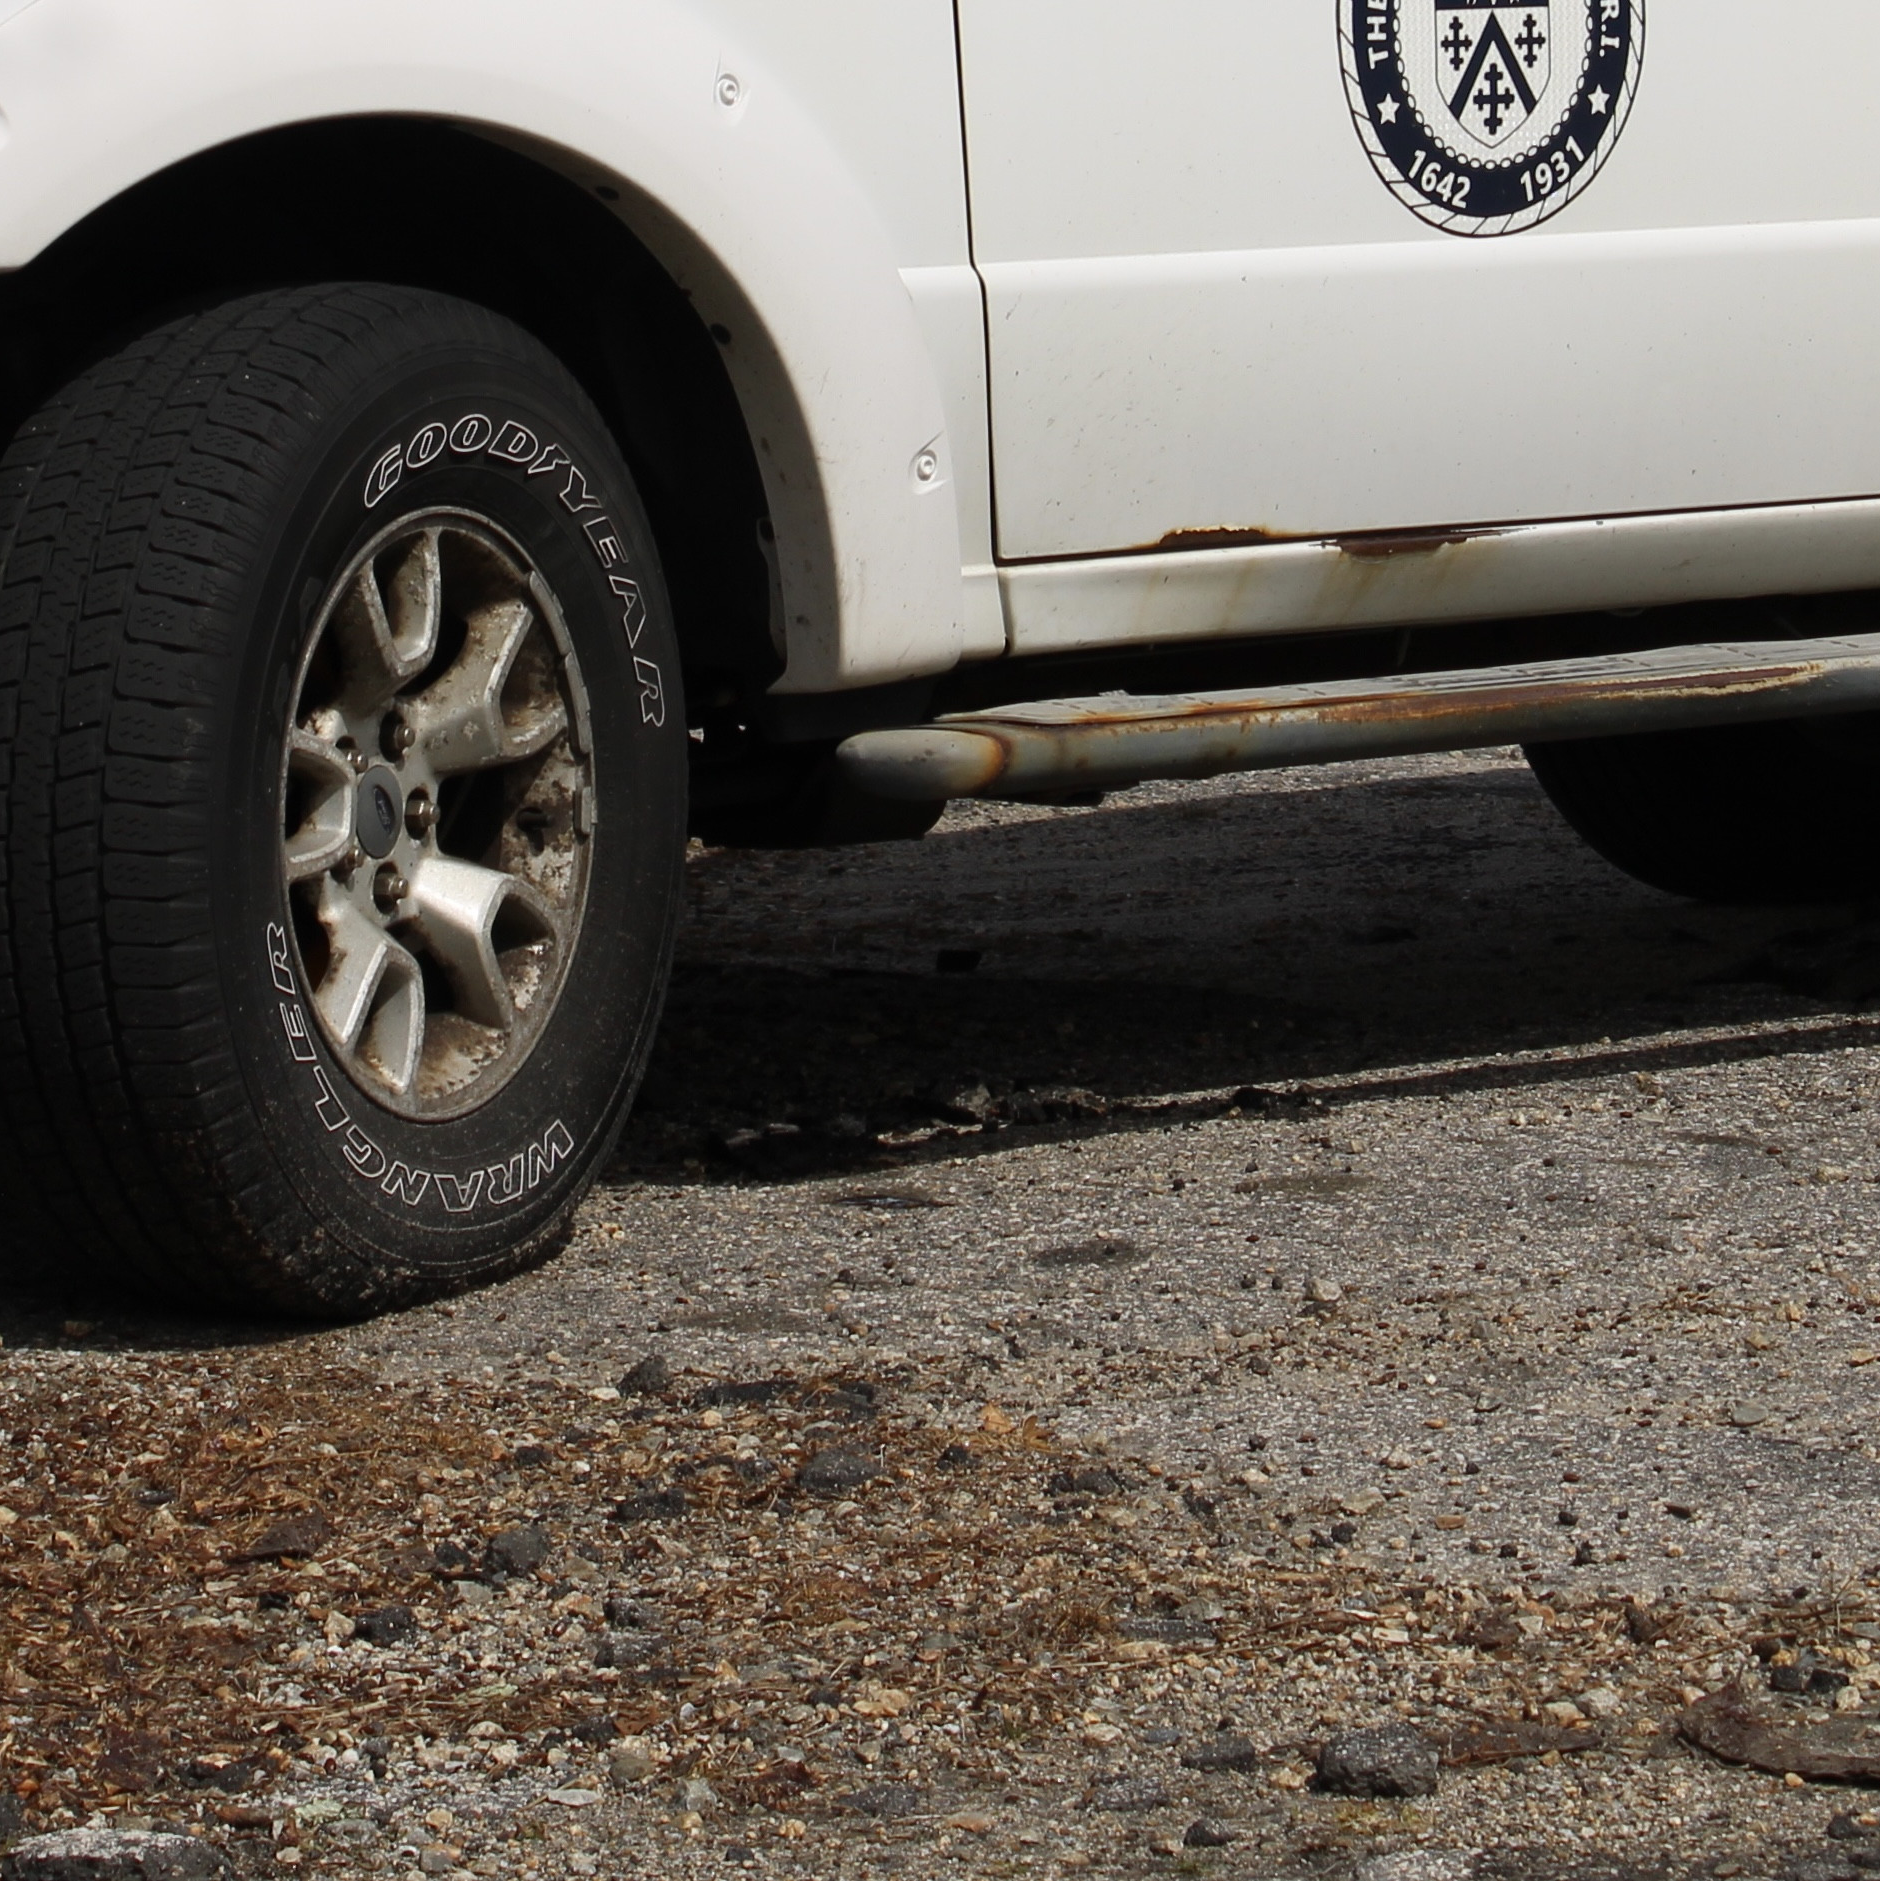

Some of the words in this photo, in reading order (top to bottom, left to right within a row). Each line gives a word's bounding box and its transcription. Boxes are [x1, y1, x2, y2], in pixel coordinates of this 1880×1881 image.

[1407, 149, 1472, 209] 1642
[1519, 135, 1586, 202] 1931
[363, 414, 666, 729] GOODYEAR
[266, 920, 575, 1213] WRANGLER
